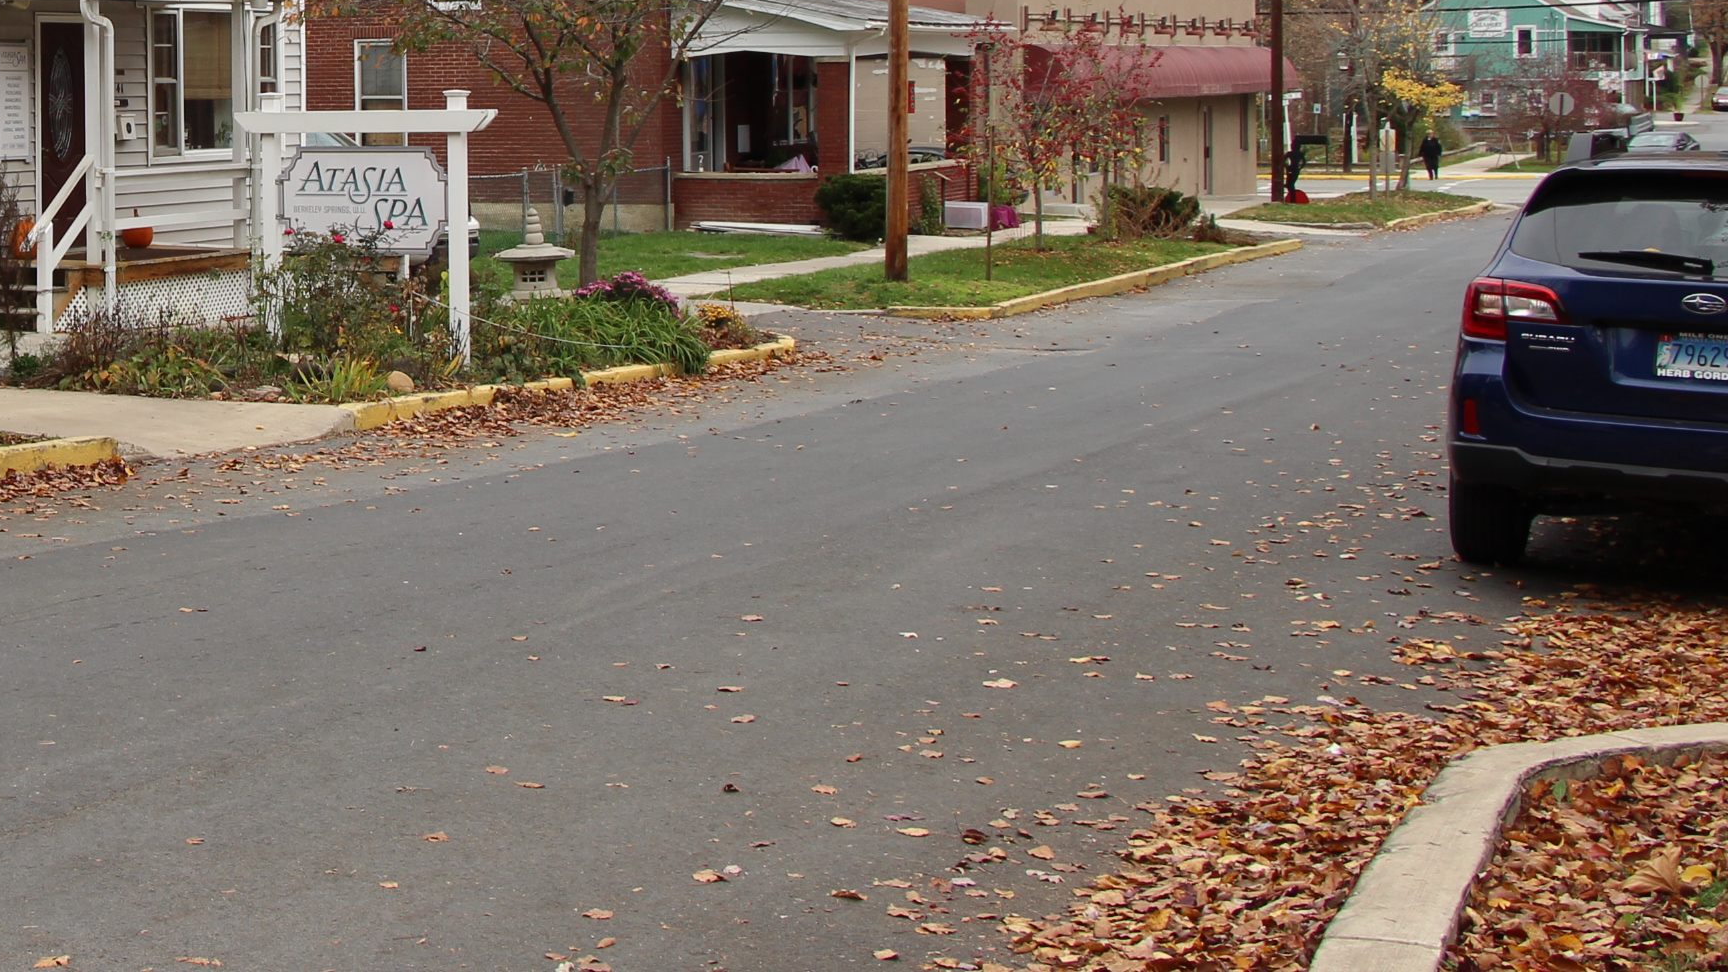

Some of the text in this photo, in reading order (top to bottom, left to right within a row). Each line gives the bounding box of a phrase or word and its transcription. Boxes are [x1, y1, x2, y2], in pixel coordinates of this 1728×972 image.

[298, 161, 408, 204] ATASIA
[293, 205, 322, 213] BERKELEY
[323, 205, 351, 215] SPRINGS,
[359, 197, 428, 234] SPA
[1656, 368, 1728, 381] HERB GORD
